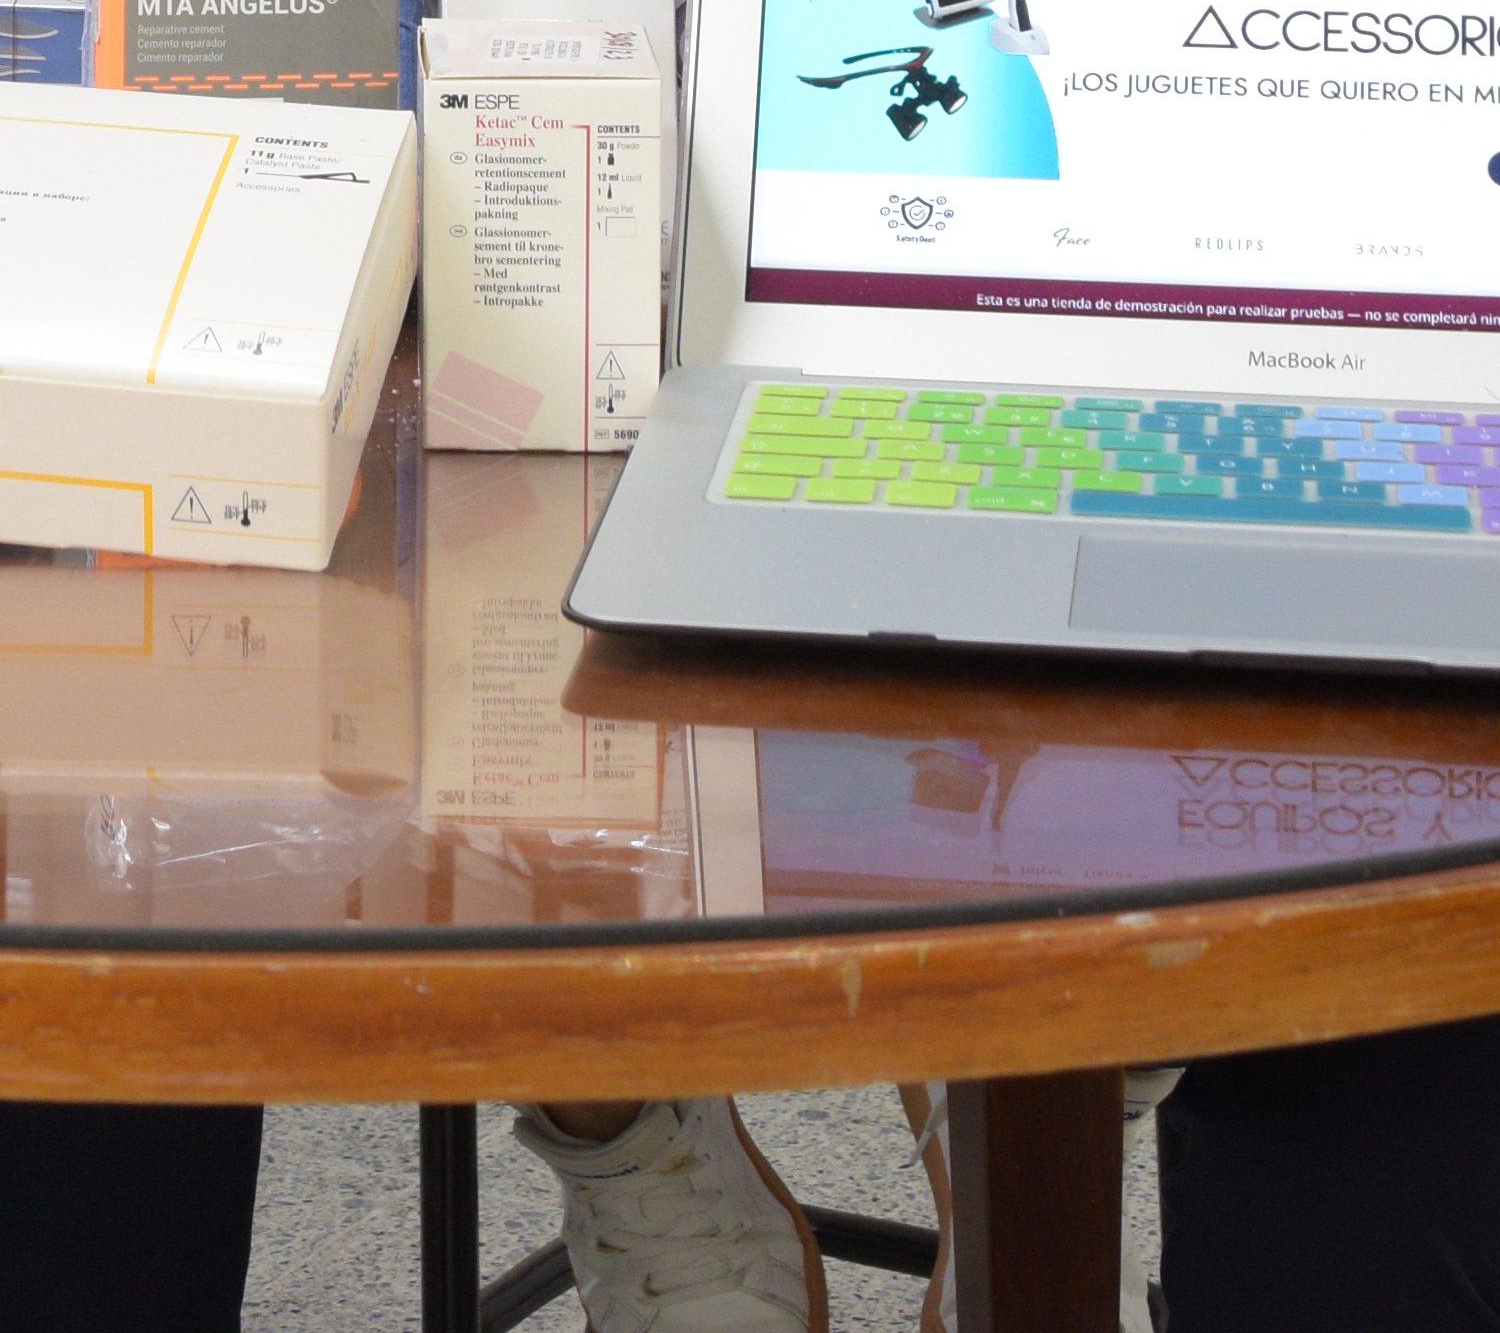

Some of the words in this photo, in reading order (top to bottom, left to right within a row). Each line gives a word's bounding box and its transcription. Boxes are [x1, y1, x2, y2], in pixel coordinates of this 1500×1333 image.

[138, 25, 187, 37] Reparative
[190, 24, 225, 34] cement
[138, 38, 179, 49] Cemento
[181, 37, 226, 50] reparador
[138, 52, 177, 63] Cimento
[180, 52, 224, 64] reparador
[1064, 72, 1117, 96] ¡LOS
[1124, 74, 1247, 97] JUGUETES
[1257, 78, 1309, 98] QUE
[1320, 80, 1418, 101] QUIERO
[1429, 83, 1463, 102] EN
[1474, 85, 1500, 103] MI
[440, 94, 469, 109] 3M
[475, 94, 520, 110] ESPE
[531, 115, 564, 130] Cem
[597, 125, 641, 134] CONTENTS
[255, 136, 329, 149] CONTENTS
[475, 133, 536, 150] Easymix
[475, 153, 547, 165] Glasionomer-
[475, 168, 566, 179] retentionscement
[236, 182, 301, 194] Accessories
[484, 181, 549, 194] Radiopaque
[484, 195, 562, 207] Introduktions-
[474, 209, 518, 221] pakning
[474, 226, 552, 238] Glassionomer-
[1053, 227, 1090, 247] Face
[474, 241, 511, 252] sement
[515, 240, 526, 251] til
[529, 240, 564, 252] krone-
[1195, 237, 1263, 251] REDLIPS
[474, 255, 493, 265] bro
[496, 255, 561, 267] sementering
[483, 268, 507, 279] Med
[474, 283, 561, 294] røntgenkontrast
[483, 296, 544, 309] Intropakke
[976, 293, 1003, 306] Esta
[1006, 296, 1020, 306] es
[1023, 297, 1048, 308] una
[1051, 297, 1092, 309] tienda
[1095, 297, 1112, 310] de
[1114, 299, 1203, 313] demostración
[1206, 304, 1236, 317] para
[1239, 304, 1287, 317] realizar
[1290, 306, 1343, 320] pruebas
[1364, 310, 1381, 321] no
[1384, 311, 1399, 322] se
[1402, 311, 1476, 325] completará
[1248, 351, 1335, 369] MacBook
[1341, 354, 1365, 370] Air
[614, 429, 639, 440] 5690
